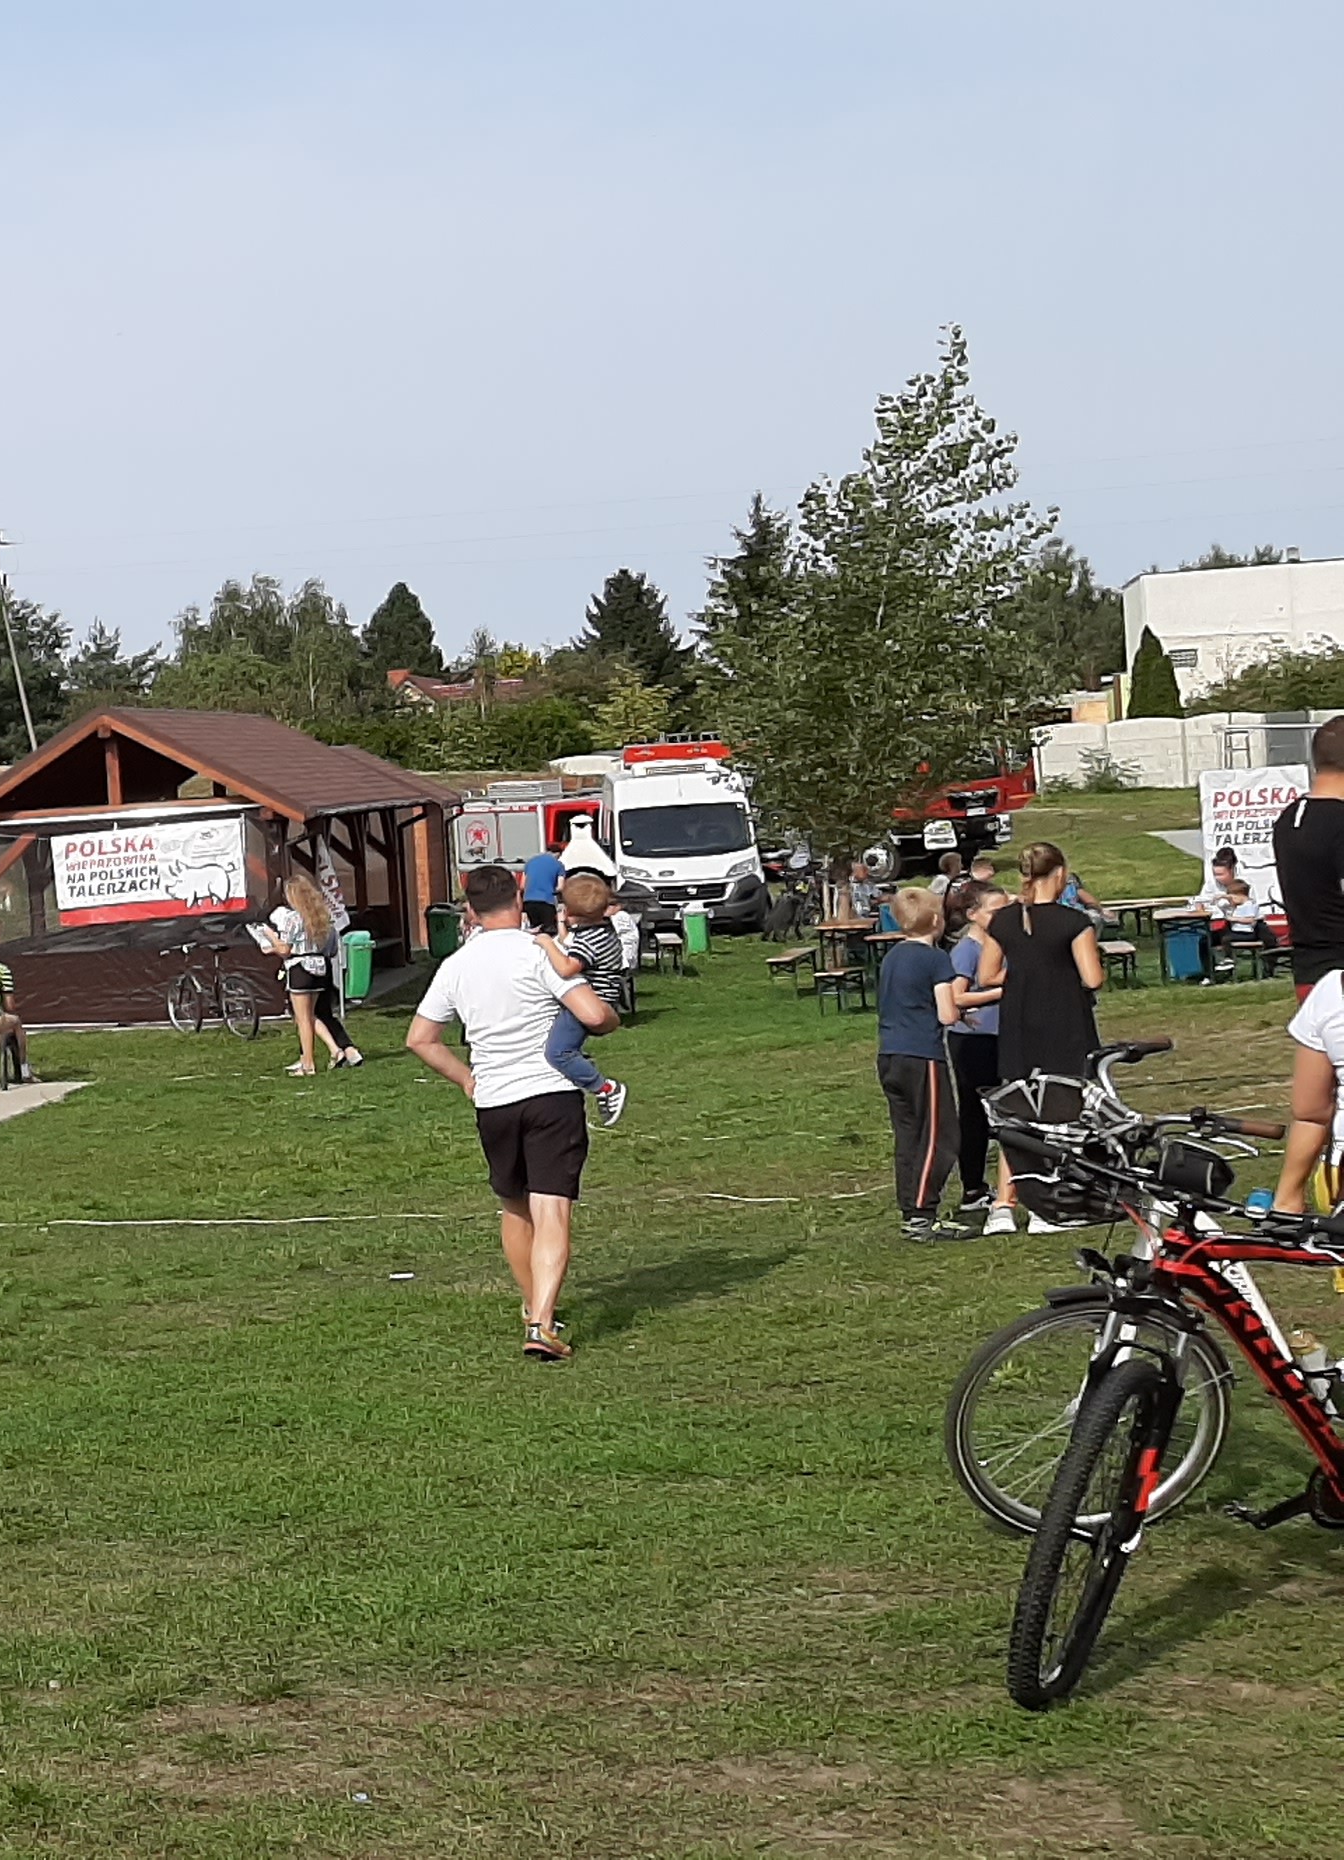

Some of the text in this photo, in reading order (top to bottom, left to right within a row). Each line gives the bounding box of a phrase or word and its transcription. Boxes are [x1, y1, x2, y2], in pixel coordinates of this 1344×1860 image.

[1213, 787, 1298, 808] POLSKA
[1214, 819, 1274, 832] NA POLS
[65, 835, 154, 859] POLSKA
[1216, 831, 1273, 846] TALERZ
[67, 865, 159, 885] NA POLSKICH
[68, 877, 160, 898] TALERZACH
